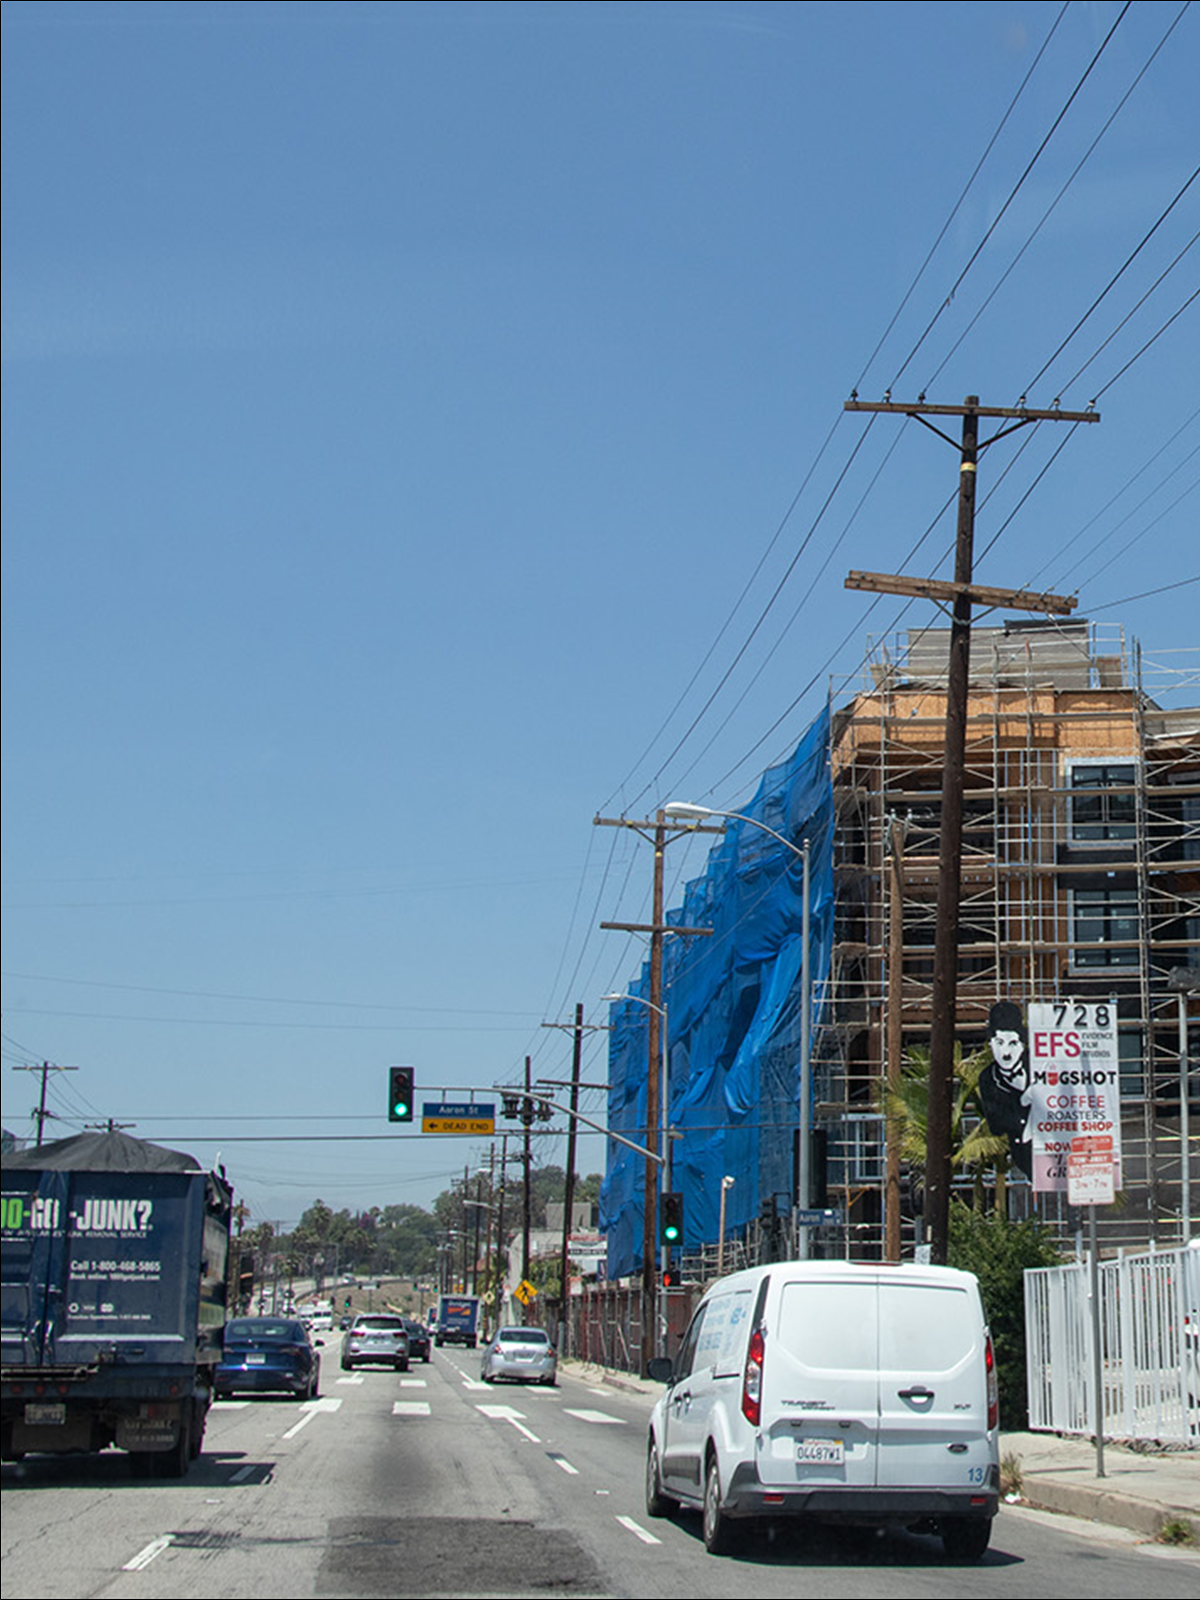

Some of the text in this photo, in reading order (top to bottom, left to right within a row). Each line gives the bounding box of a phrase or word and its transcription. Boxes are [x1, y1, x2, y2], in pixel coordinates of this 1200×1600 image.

[1053, 1004, 1110, 1027] 728
[1081, 1032, 1113, 1040] EVIDENCE
[1034, 1031, 1081, 1058] EFS
[1081, 1050, 1111, 1058] STUDIOS
[1046, 1094, 1105, 1109] COFFEE
[439, 1106, 479, 1114] Aaron St
[1047, 1110, 1106, 1120] ROASTERS
[443, 1122, 489, 1130] DEAD END
[1037, 1120, 1113, 1132] COFFEE SHOP
[70, 1260, 89, 1271] Call
[968, 1467, 984, 1483] 13
